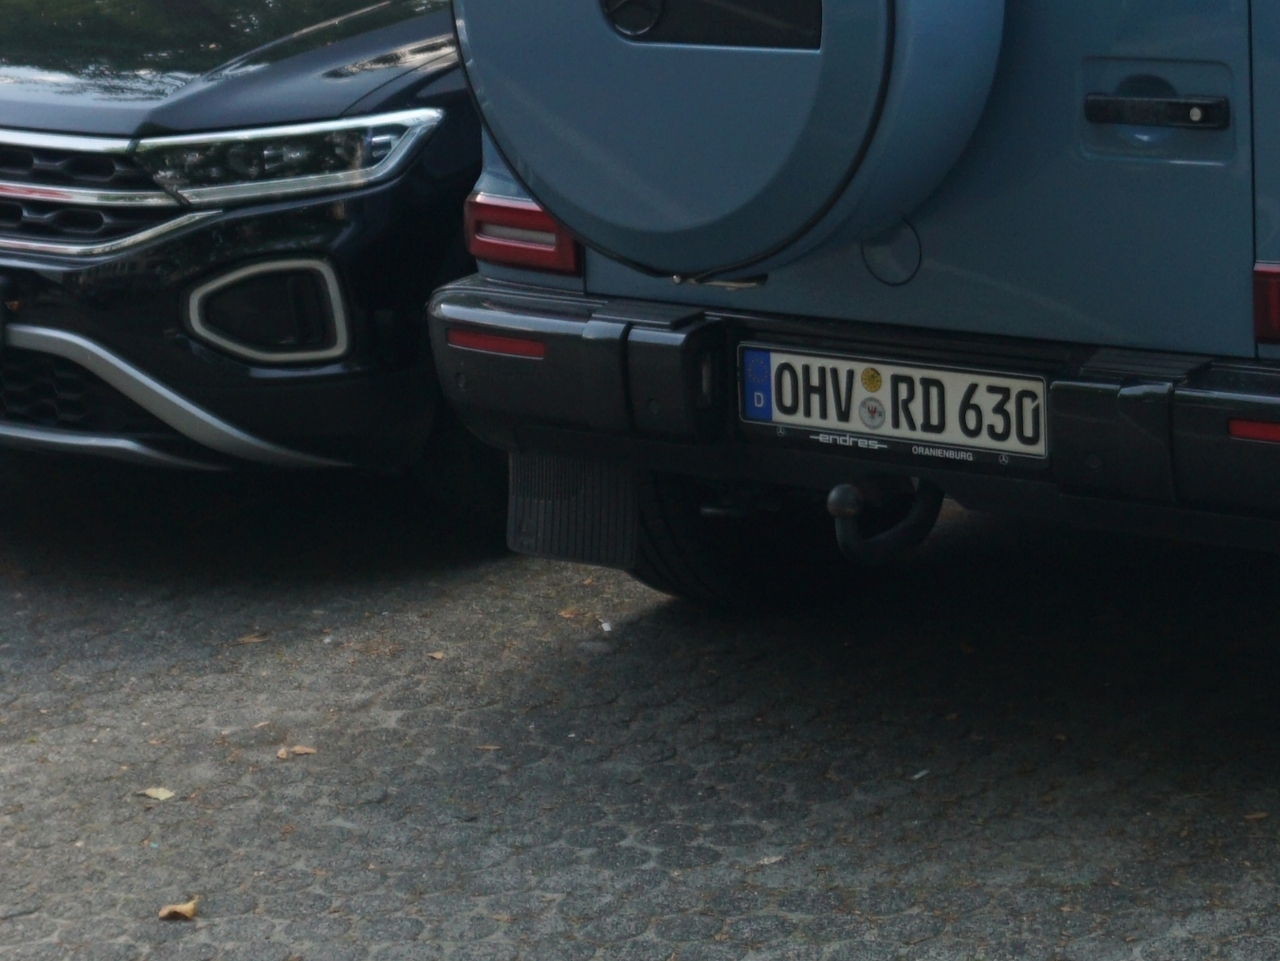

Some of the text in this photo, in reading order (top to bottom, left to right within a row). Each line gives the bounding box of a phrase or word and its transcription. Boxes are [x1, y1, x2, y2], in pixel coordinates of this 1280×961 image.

[754, 392, 764, 408] D
[774, 361, 1041, 446] OHV RD 630
[911, 445, 974, 461] ORANIENBURG
